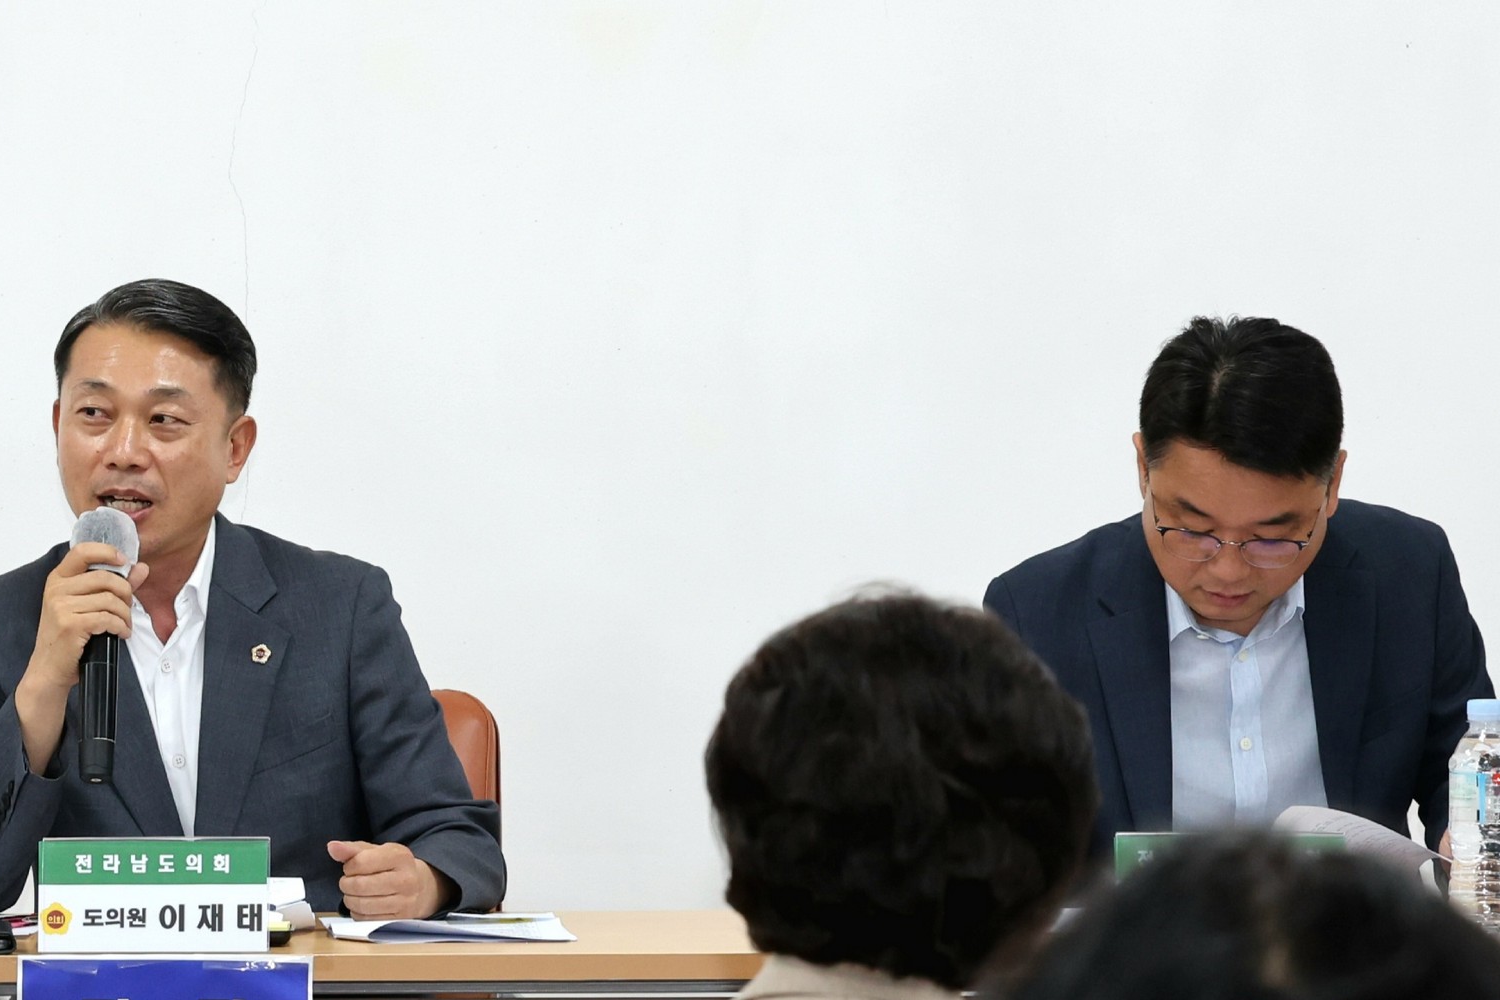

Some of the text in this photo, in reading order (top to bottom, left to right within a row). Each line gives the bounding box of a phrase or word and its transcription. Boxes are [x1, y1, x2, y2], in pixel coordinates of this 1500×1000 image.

[75, 854, 230, 874] 전라남도의회
[46, 915, 66, 925] 의회
[82, 903, 263, 932] 도의원 이재태
